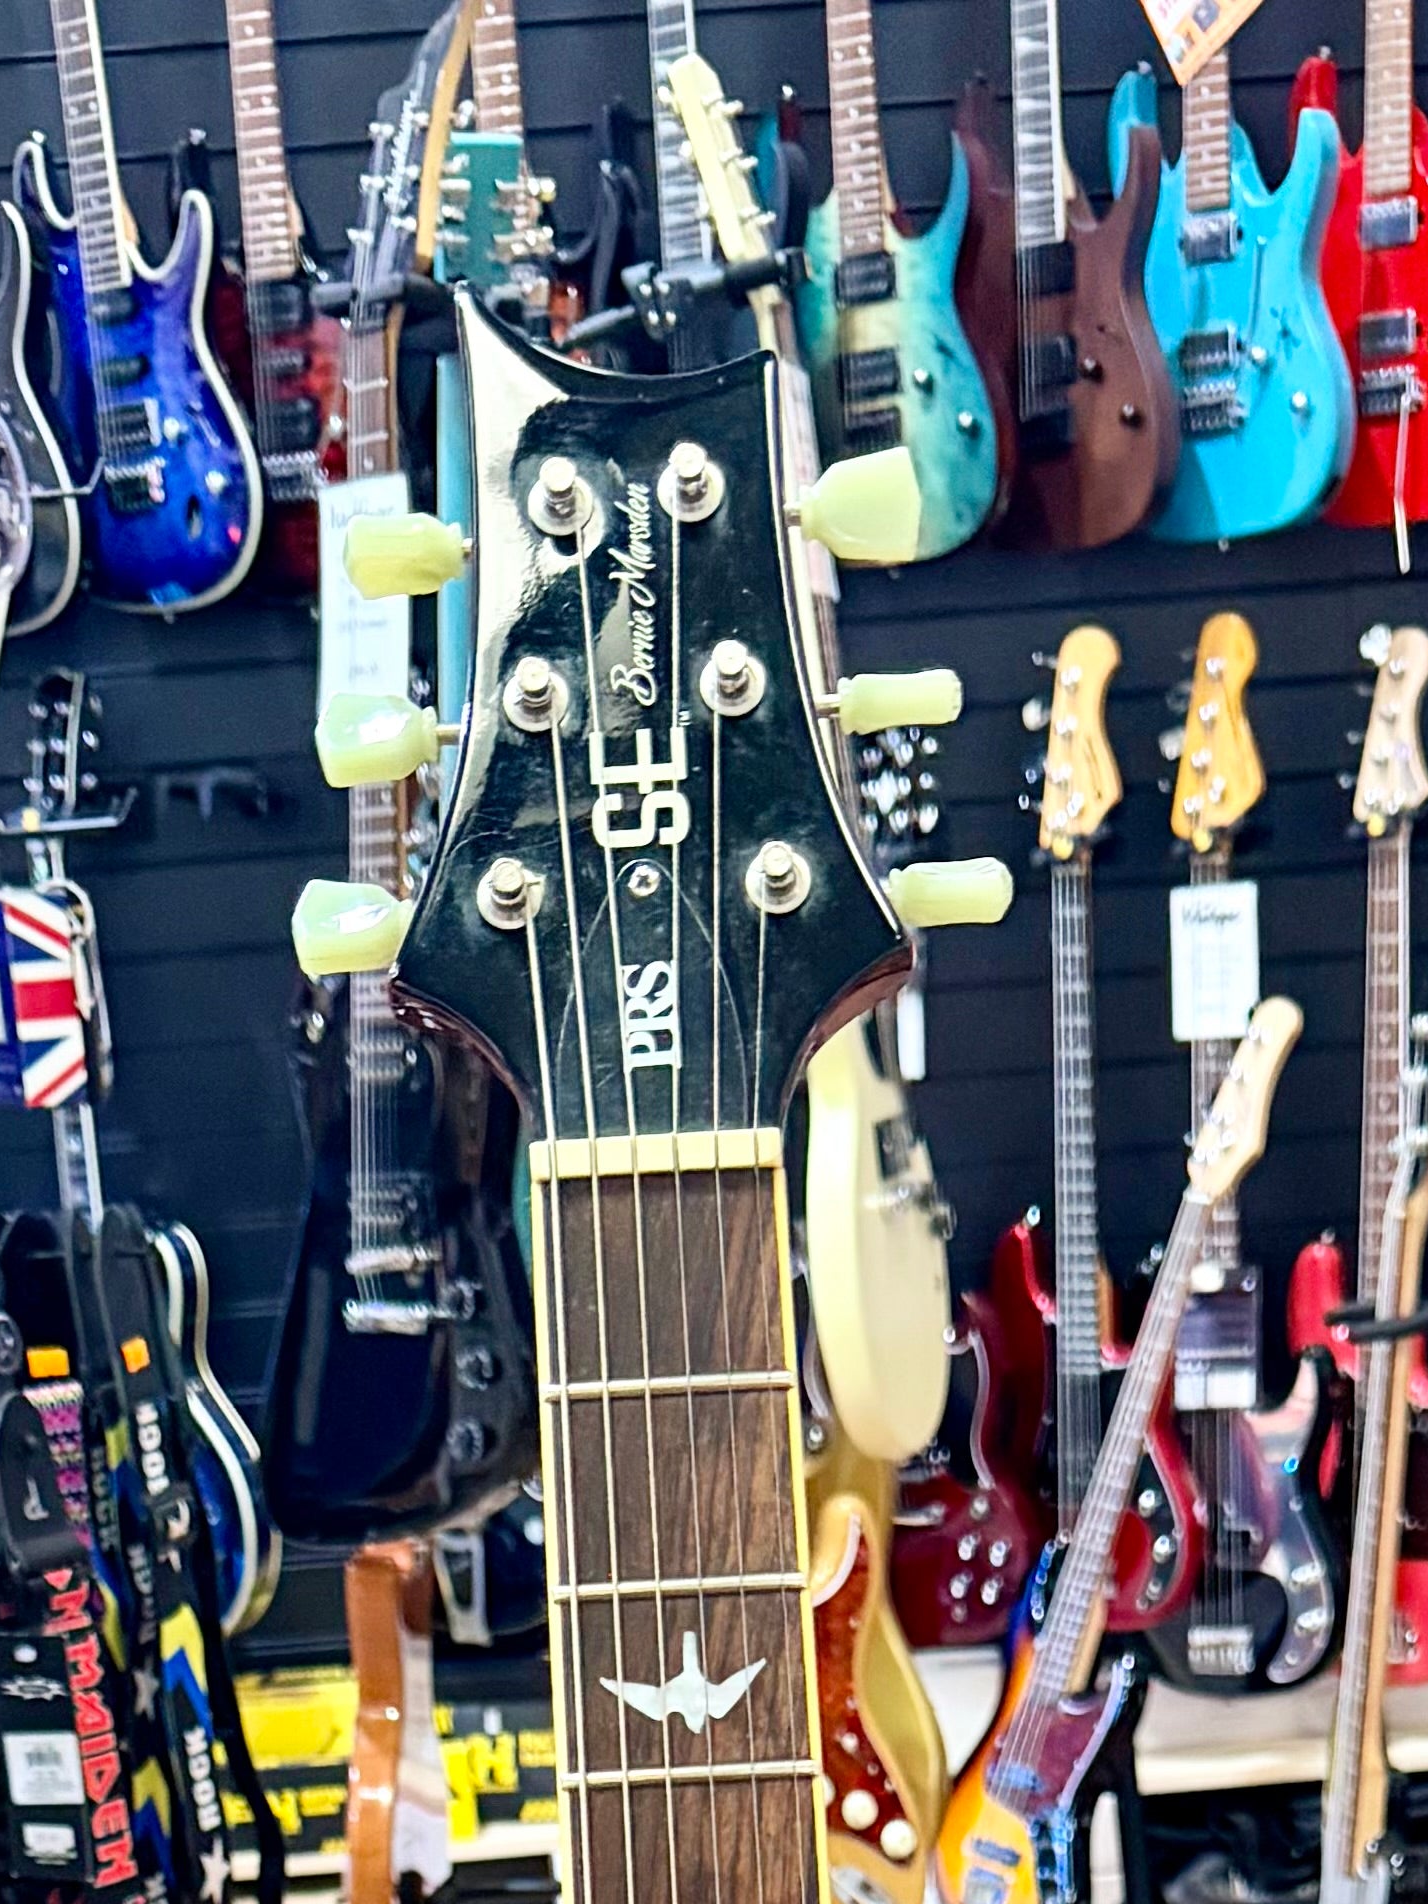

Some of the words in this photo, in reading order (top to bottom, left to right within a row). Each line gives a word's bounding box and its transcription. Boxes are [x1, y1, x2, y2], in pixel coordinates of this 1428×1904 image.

[606, 482, 657, 607] Marsden
[608, 610, 657, 707] Bernie
[589, 727, 691, 850] SE
[622, 958, 680, 1073] PRS
[64, 1632, 138, 1889] MAIDEN
[183, 1725, 223, 1833] ROCK
